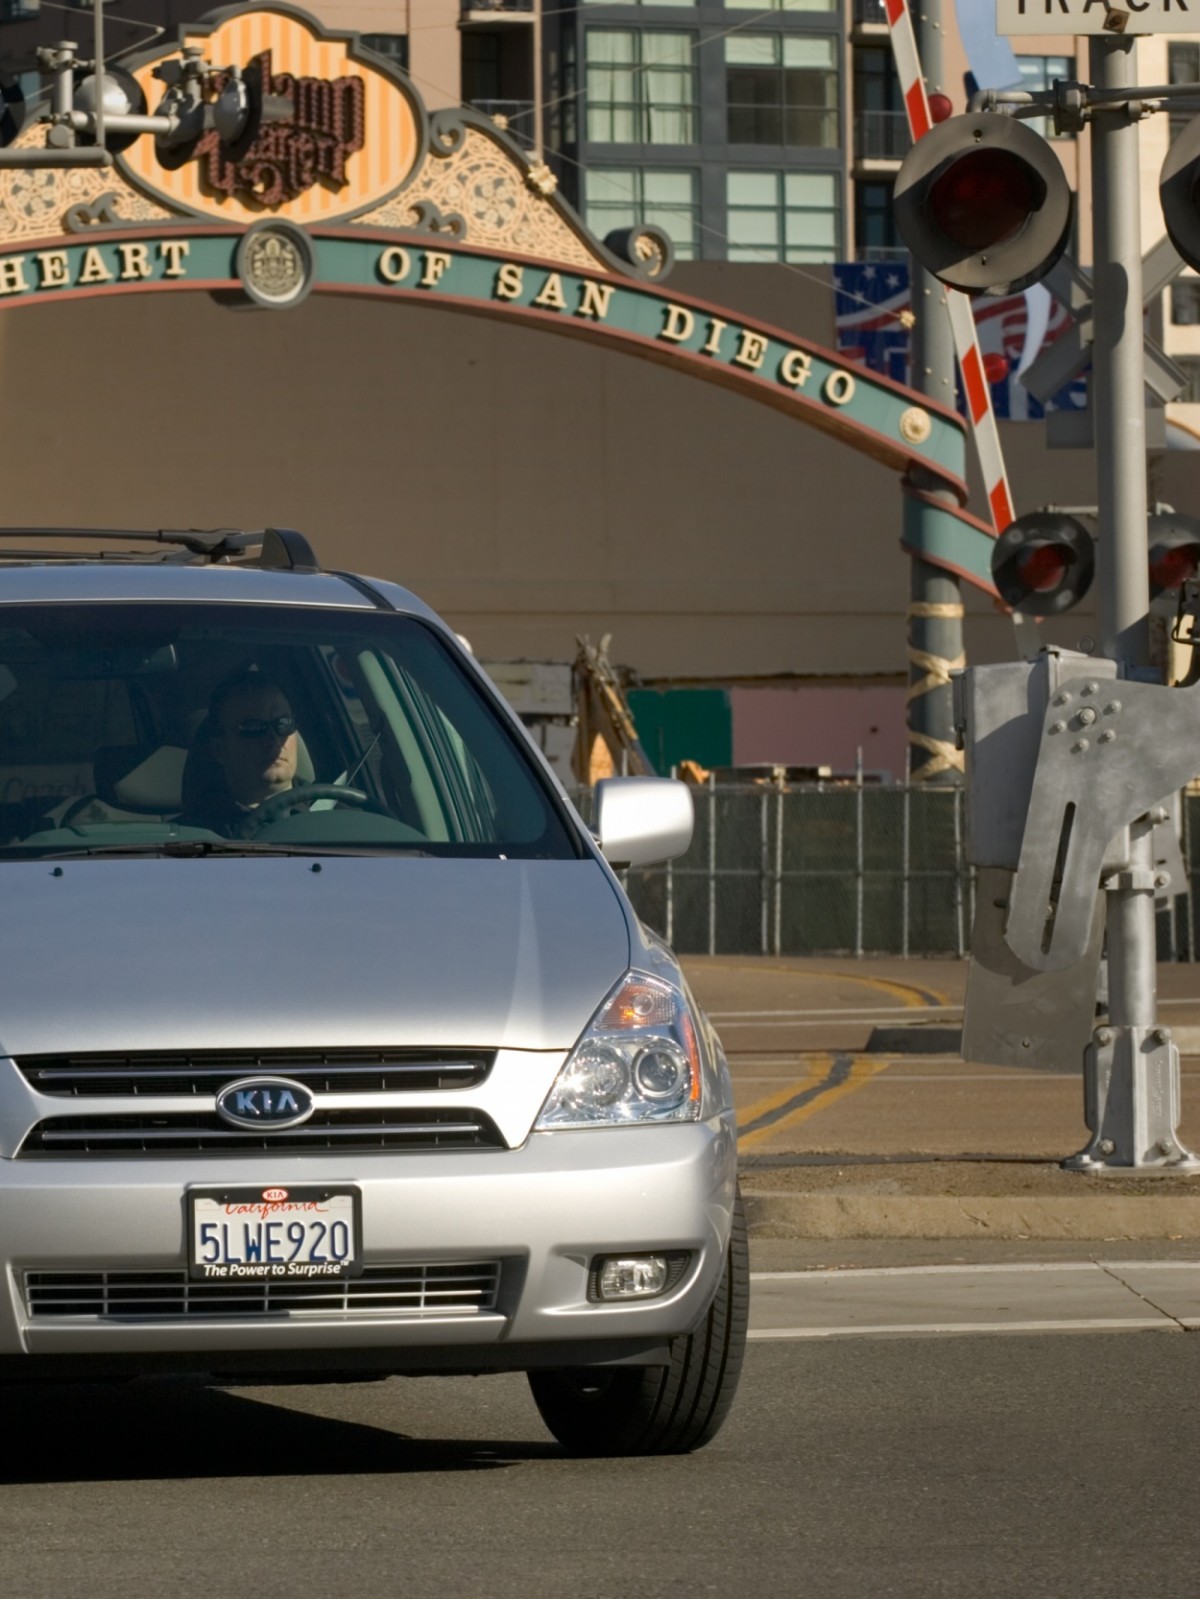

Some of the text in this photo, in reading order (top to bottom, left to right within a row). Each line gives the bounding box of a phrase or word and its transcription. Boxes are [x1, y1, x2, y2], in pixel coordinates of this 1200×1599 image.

[379, 247, 451, 286] OF
[497, 263, 616, 319] SAN
[661, 303, 856, 405] DIEGO
[236, 1091, 299, 1115] KIA
[266, 1191, 284, 1199] KIA
[225, 1201, 329, 1220] California
[201, 1220, 349, 1263] 5LWE920
[204, 1264, 227, 1277] The
[229, 1263, 270, 1276] Power
[272, 1264, 286, 1275] to
